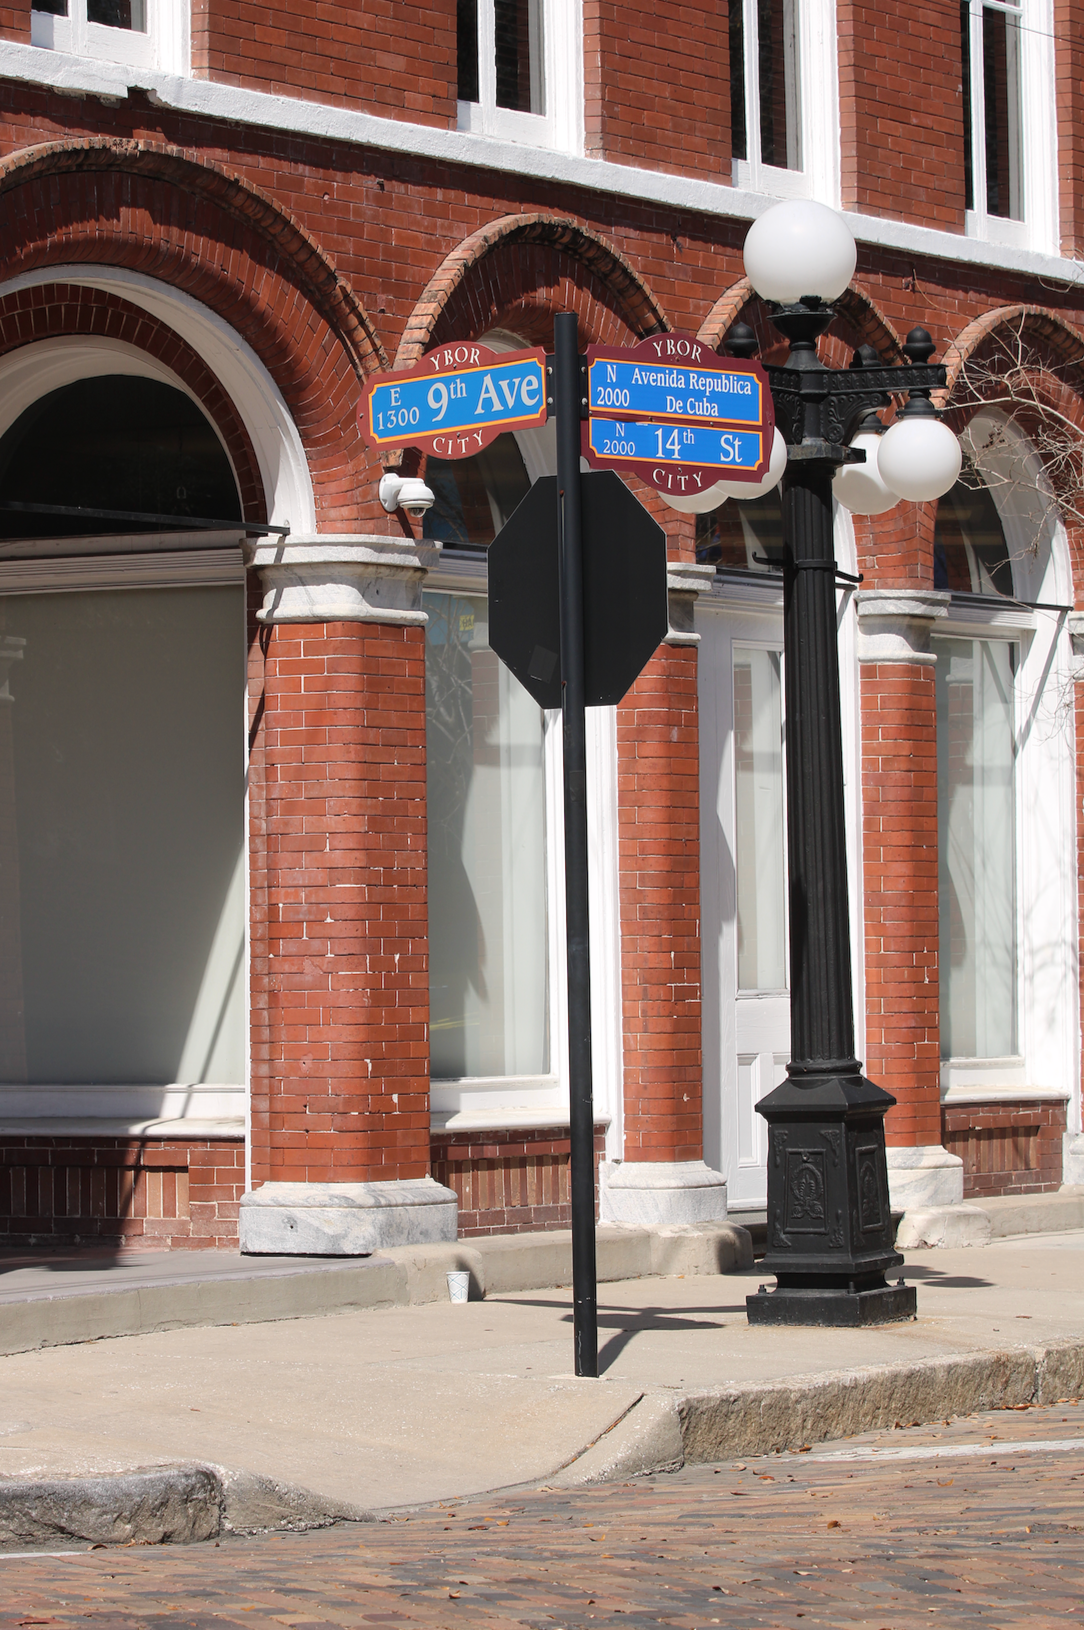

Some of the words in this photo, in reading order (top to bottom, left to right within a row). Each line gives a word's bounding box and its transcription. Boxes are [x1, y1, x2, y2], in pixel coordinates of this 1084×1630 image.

[429, 346, 480, 371] YBOR
[652, 339, 702, 363] YBOR
[606, 364, 617, 383] N
[631, 367, 685, 389] Avenida
[688, 373, 752, 396] Republica
[390, 387, 401, 407] E
[427, 377, 467, 422] 9th
[474, 373, 540, 415] Ave
[596, 386, 630, 407] 2000
[666, 395, 684, 413] De
[686, 398, 719, 417] Cuba
[376, 406, 420, 430] 1300
[615, 422, 625, 437] N
[432, 429, 483, 455] CITY
[603, 439, 636, 456] 2000
[654, 427, 695, 459] 14th
[720, 433, 743, 463] St
[652, 468, 703, 491] CITY
